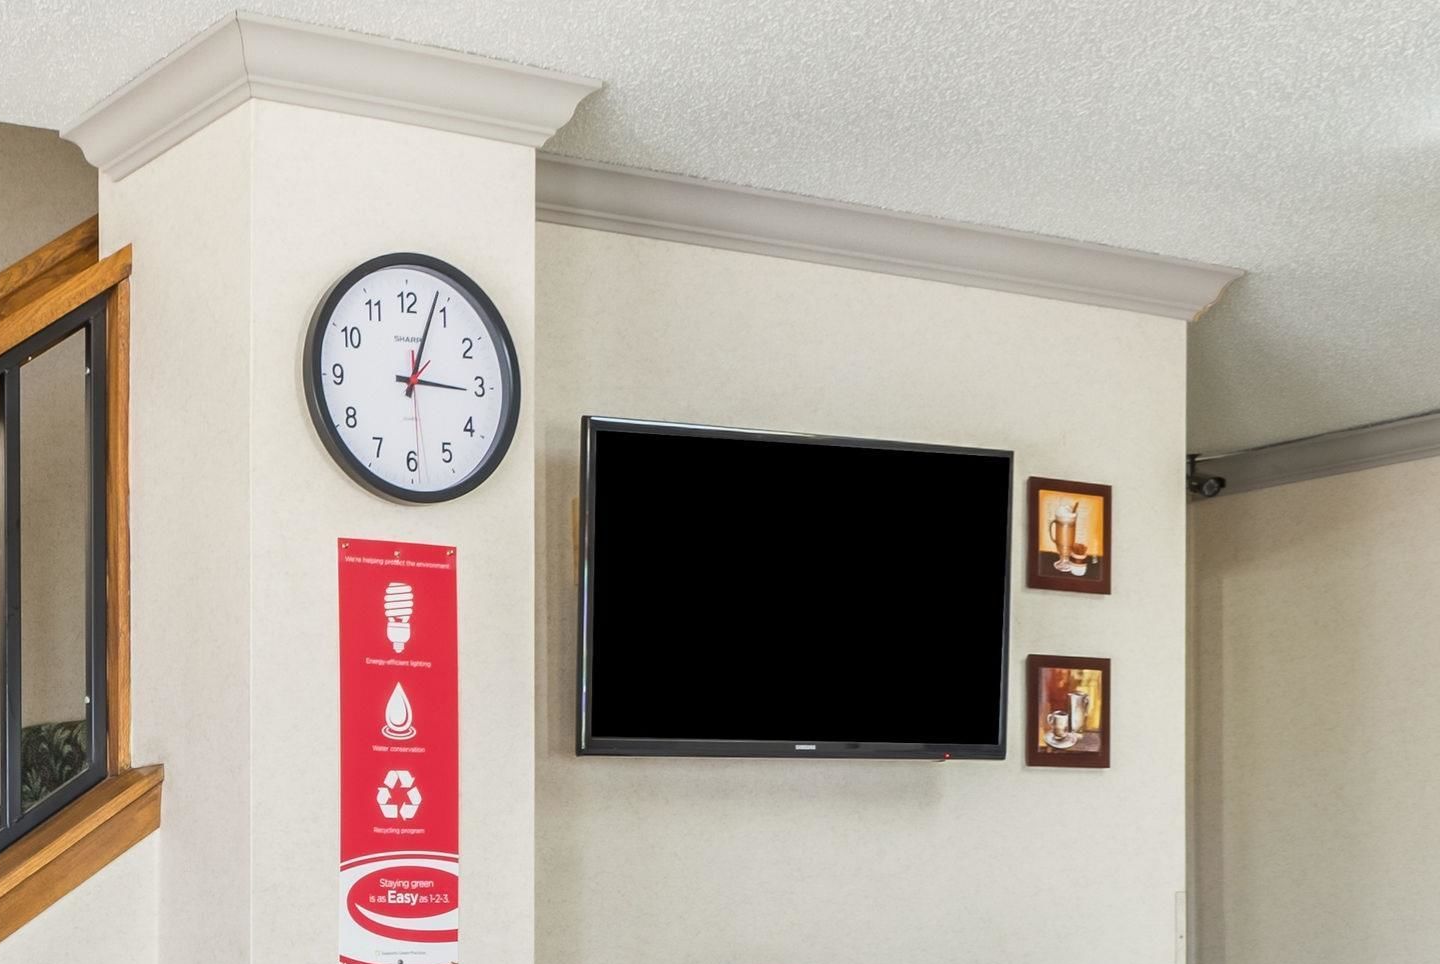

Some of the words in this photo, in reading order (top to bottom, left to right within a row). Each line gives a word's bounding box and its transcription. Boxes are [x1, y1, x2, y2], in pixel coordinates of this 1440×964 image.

[365, 299, 382, 322] 11
[397, 291, 417, 314] 12
[439, 306, 447, 328] 1
[341, 326, 361, 349] 10
[462, 337, 473, 359] 2
[332, 363, 344, 385] 9
[474, 376, 485, 397] 3
[345, 406, 357, 428] 8
[463, 416, 475, 437] 4
[372, 437, 383, 458] 7
[442, 442, 453, 463] 5
[406, 451, 418, 472] 6
[379, 878, 409, 889] Staying
[411, 881, 434, 889] green
[369, 894, 376, 903] is
[387, 890, 418, 906] Easy
